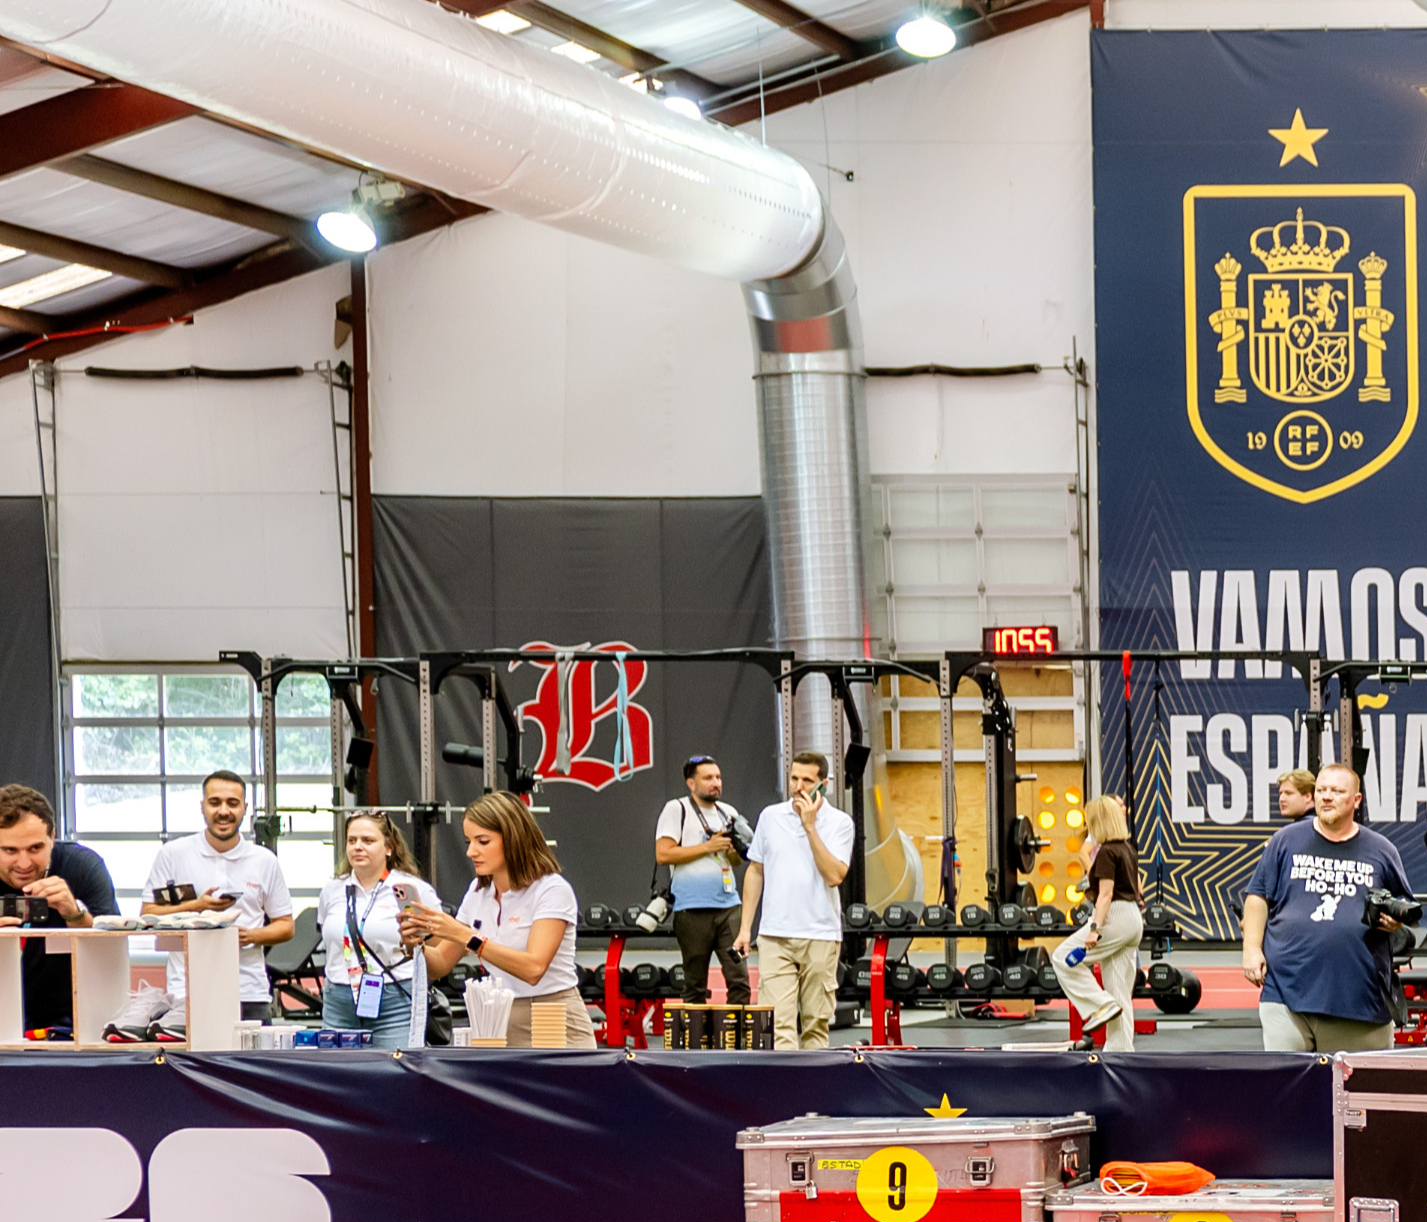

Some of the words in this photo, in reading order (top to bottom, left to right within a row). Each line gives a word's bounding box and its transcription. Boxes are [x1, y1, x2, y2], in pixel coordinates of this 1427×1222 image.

[1246, 432, 1267, 449] 19
[1292, 854, 1334, 871] WAKE
[1334, 859, 1357, 872] ME
[1357, 862, 1374, 874] UP
[1290, 866, 1345, 883] BEFORE
[1345, 871, 1374, 888] YOU
[1305, 879, 1357, 897] HO-HO
[888, 1161, 907, 1211] 9
